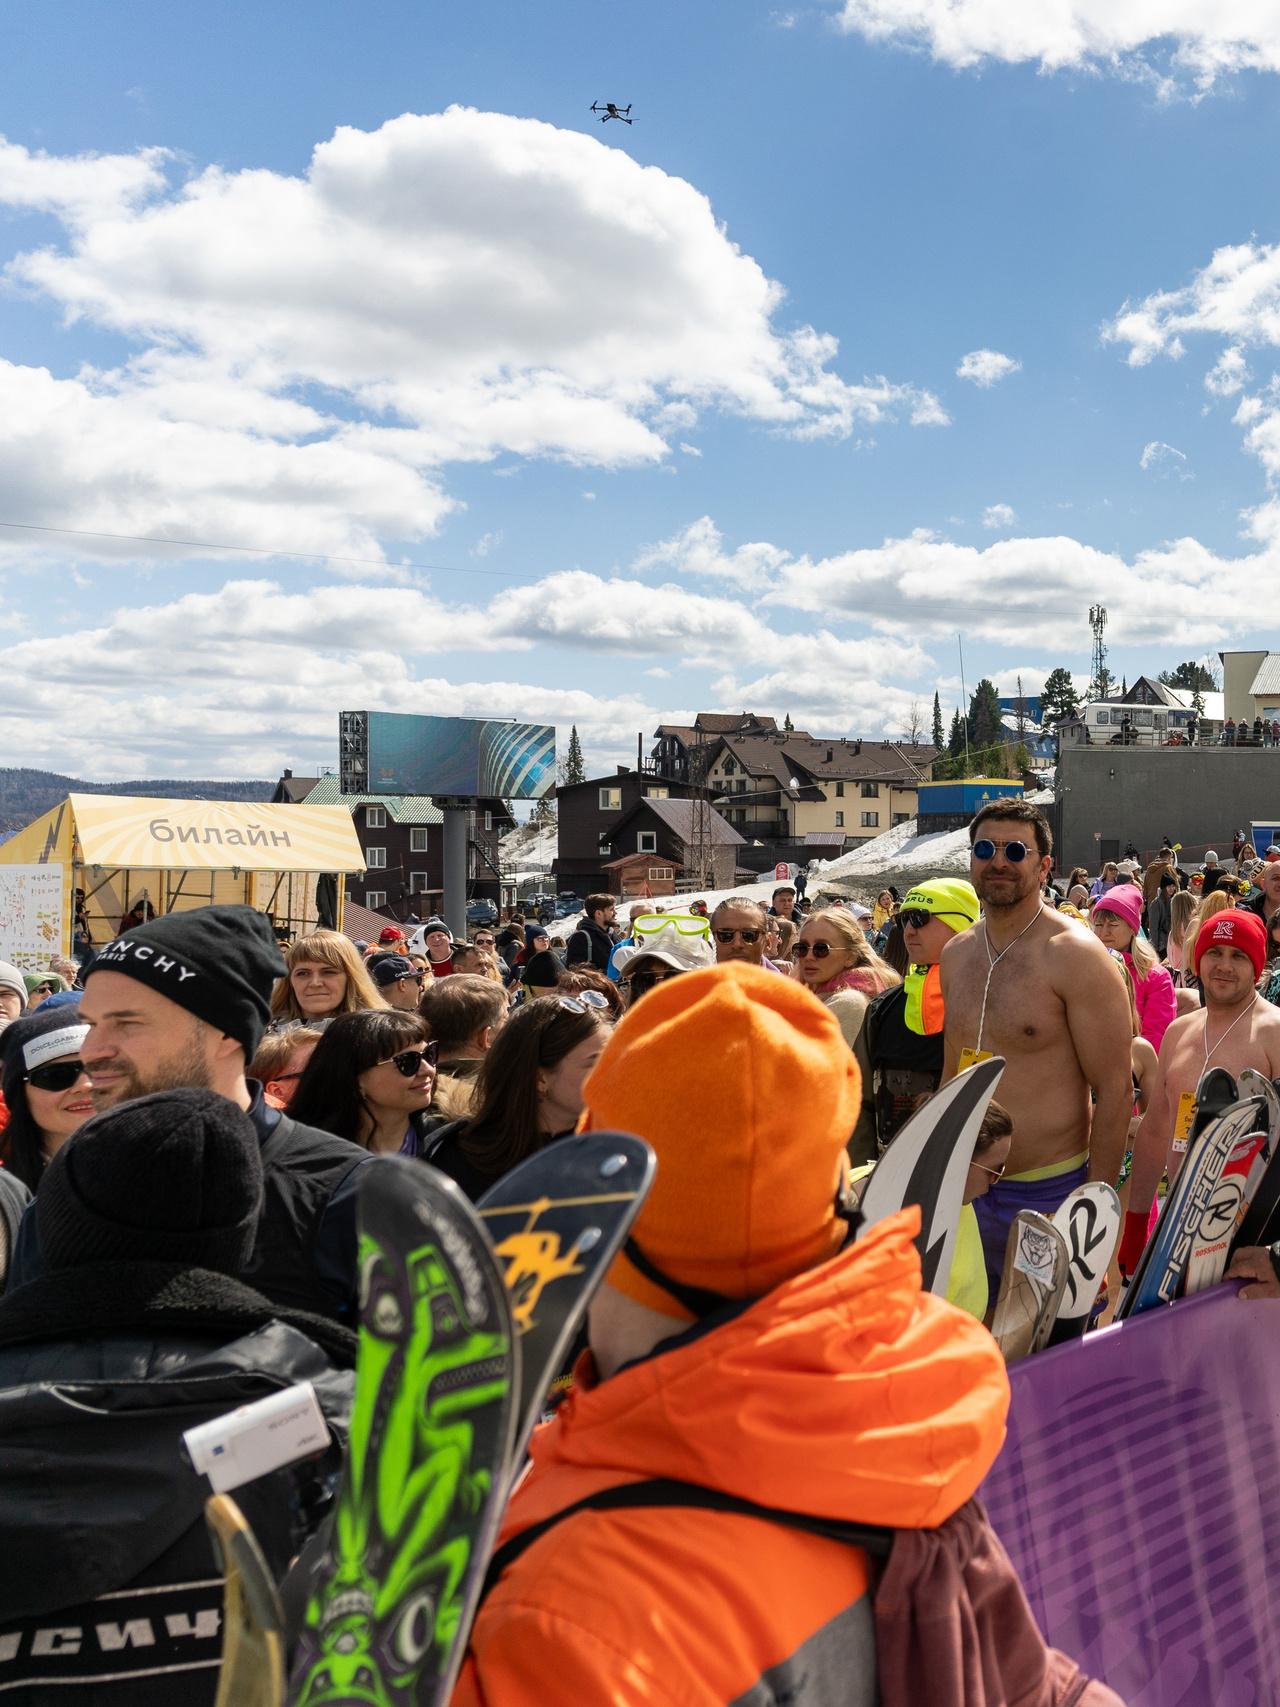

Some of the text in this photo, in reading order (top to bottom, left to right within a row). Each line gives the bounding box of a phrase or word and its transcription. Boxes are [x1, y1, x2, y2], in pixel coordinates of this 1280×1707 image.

[149, 818, 292, 847] билайн
[100, 940, 197, 983] ENCHY
[1157, 1120, 1240, 1302] FISCHER
[1066, 1197, 1107, 1309] K2
